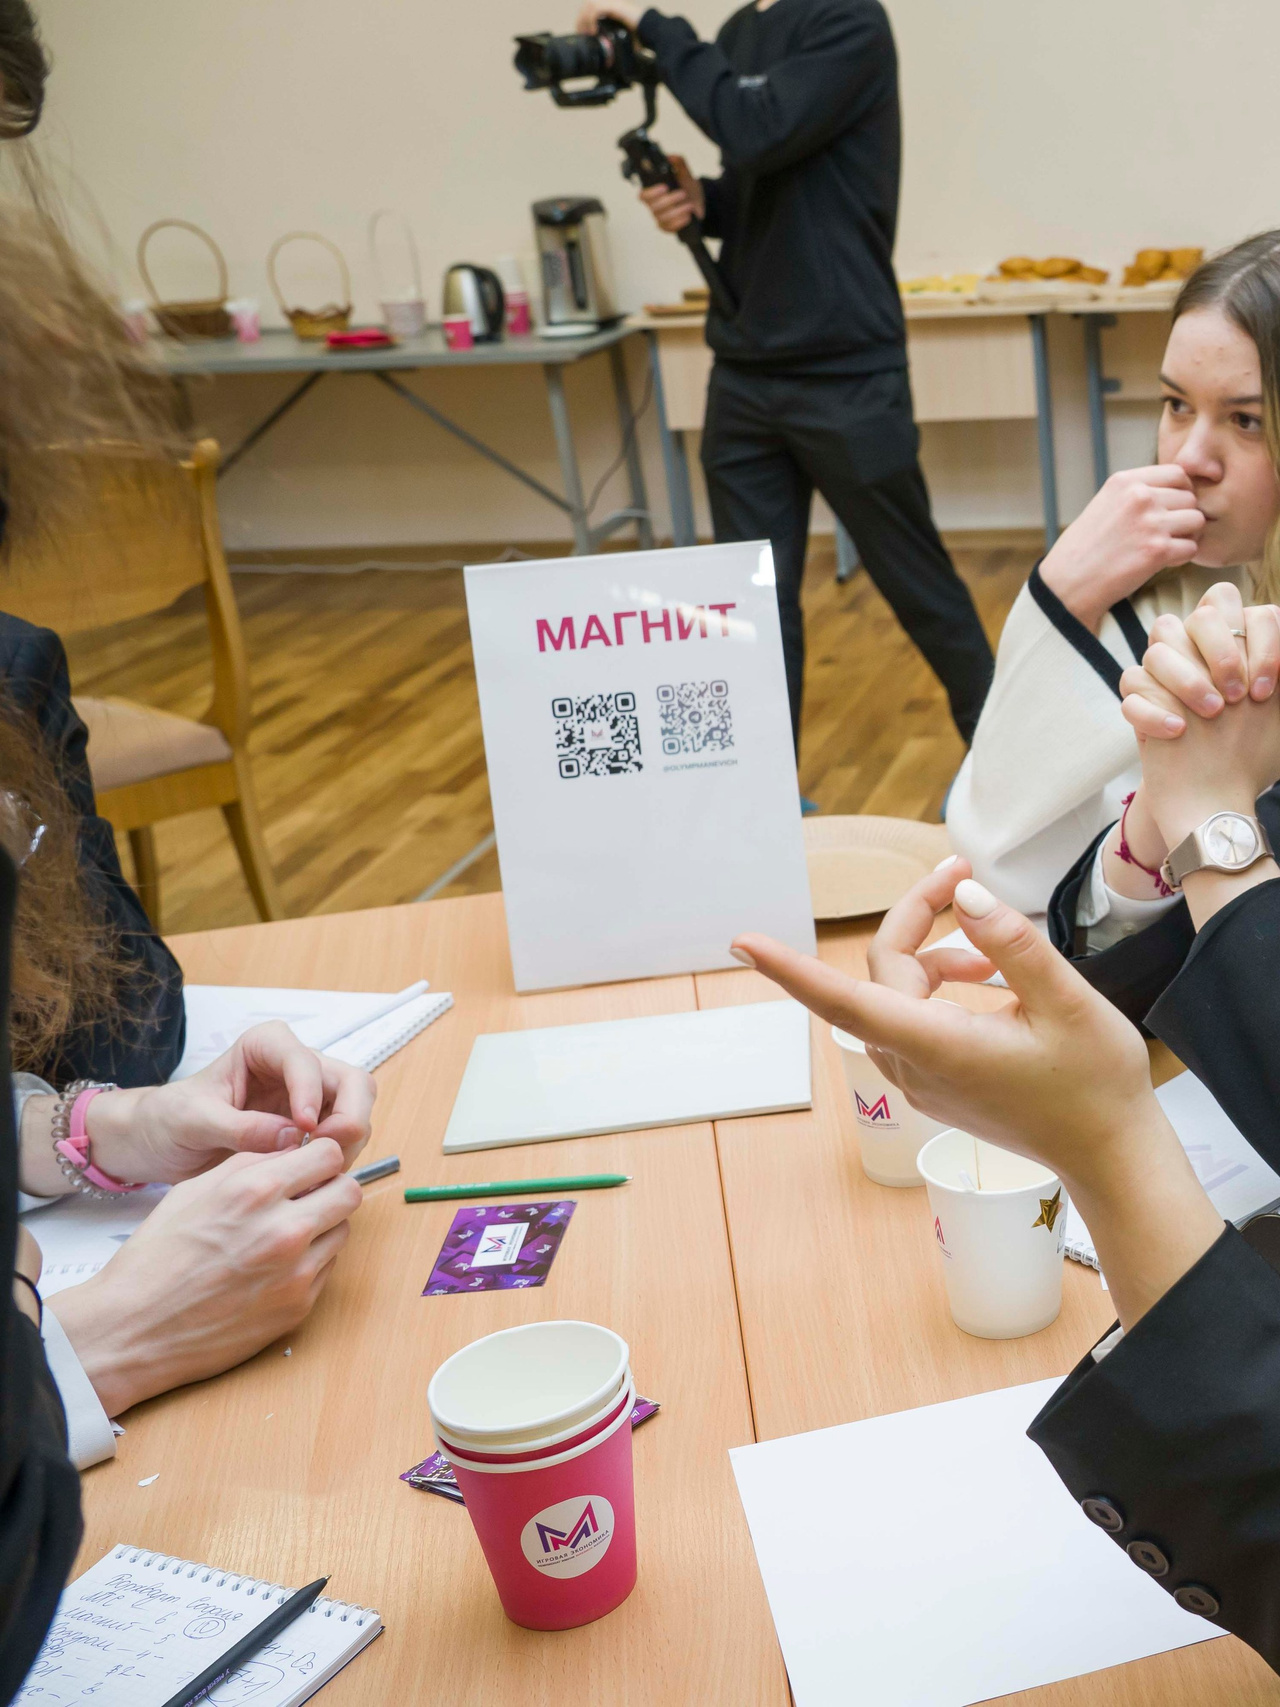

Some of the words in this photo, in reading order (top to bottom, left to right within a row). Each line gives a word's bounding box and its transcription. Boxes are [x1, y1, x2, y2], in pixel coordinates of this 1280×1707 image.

[536, 603, 736, 652] МАГНИТ
[536, 1553, 568, 1564] ИГРОВАЯ
[570, 1529, 609, 1555] ЭКОНОМИКА
